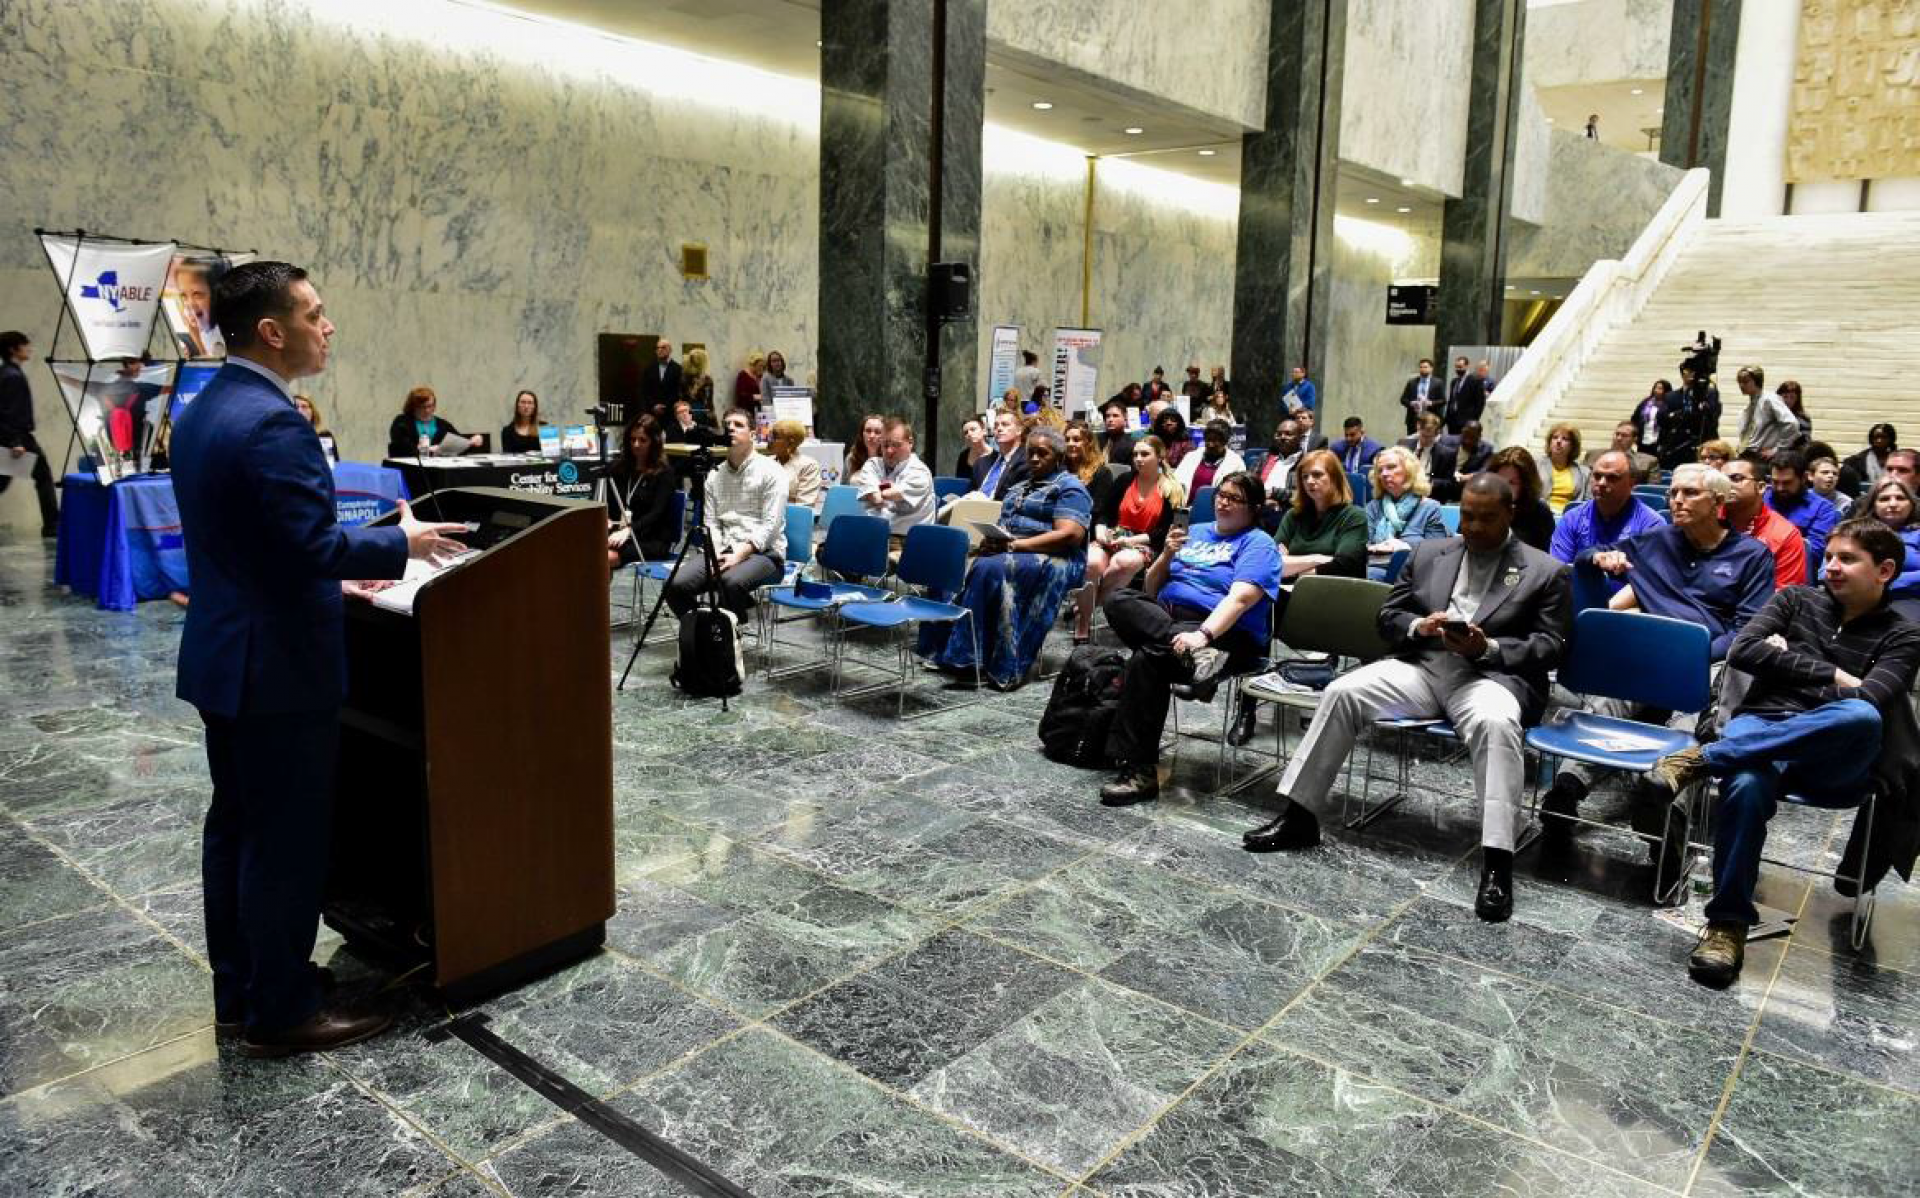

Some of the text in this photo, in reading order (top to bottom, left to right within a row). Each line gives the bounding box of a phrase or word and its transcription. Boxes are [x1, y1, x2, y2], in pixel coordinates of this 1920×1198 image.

[510, 471, 558, 484] Center for
[556, 482, 592, 494] Services
